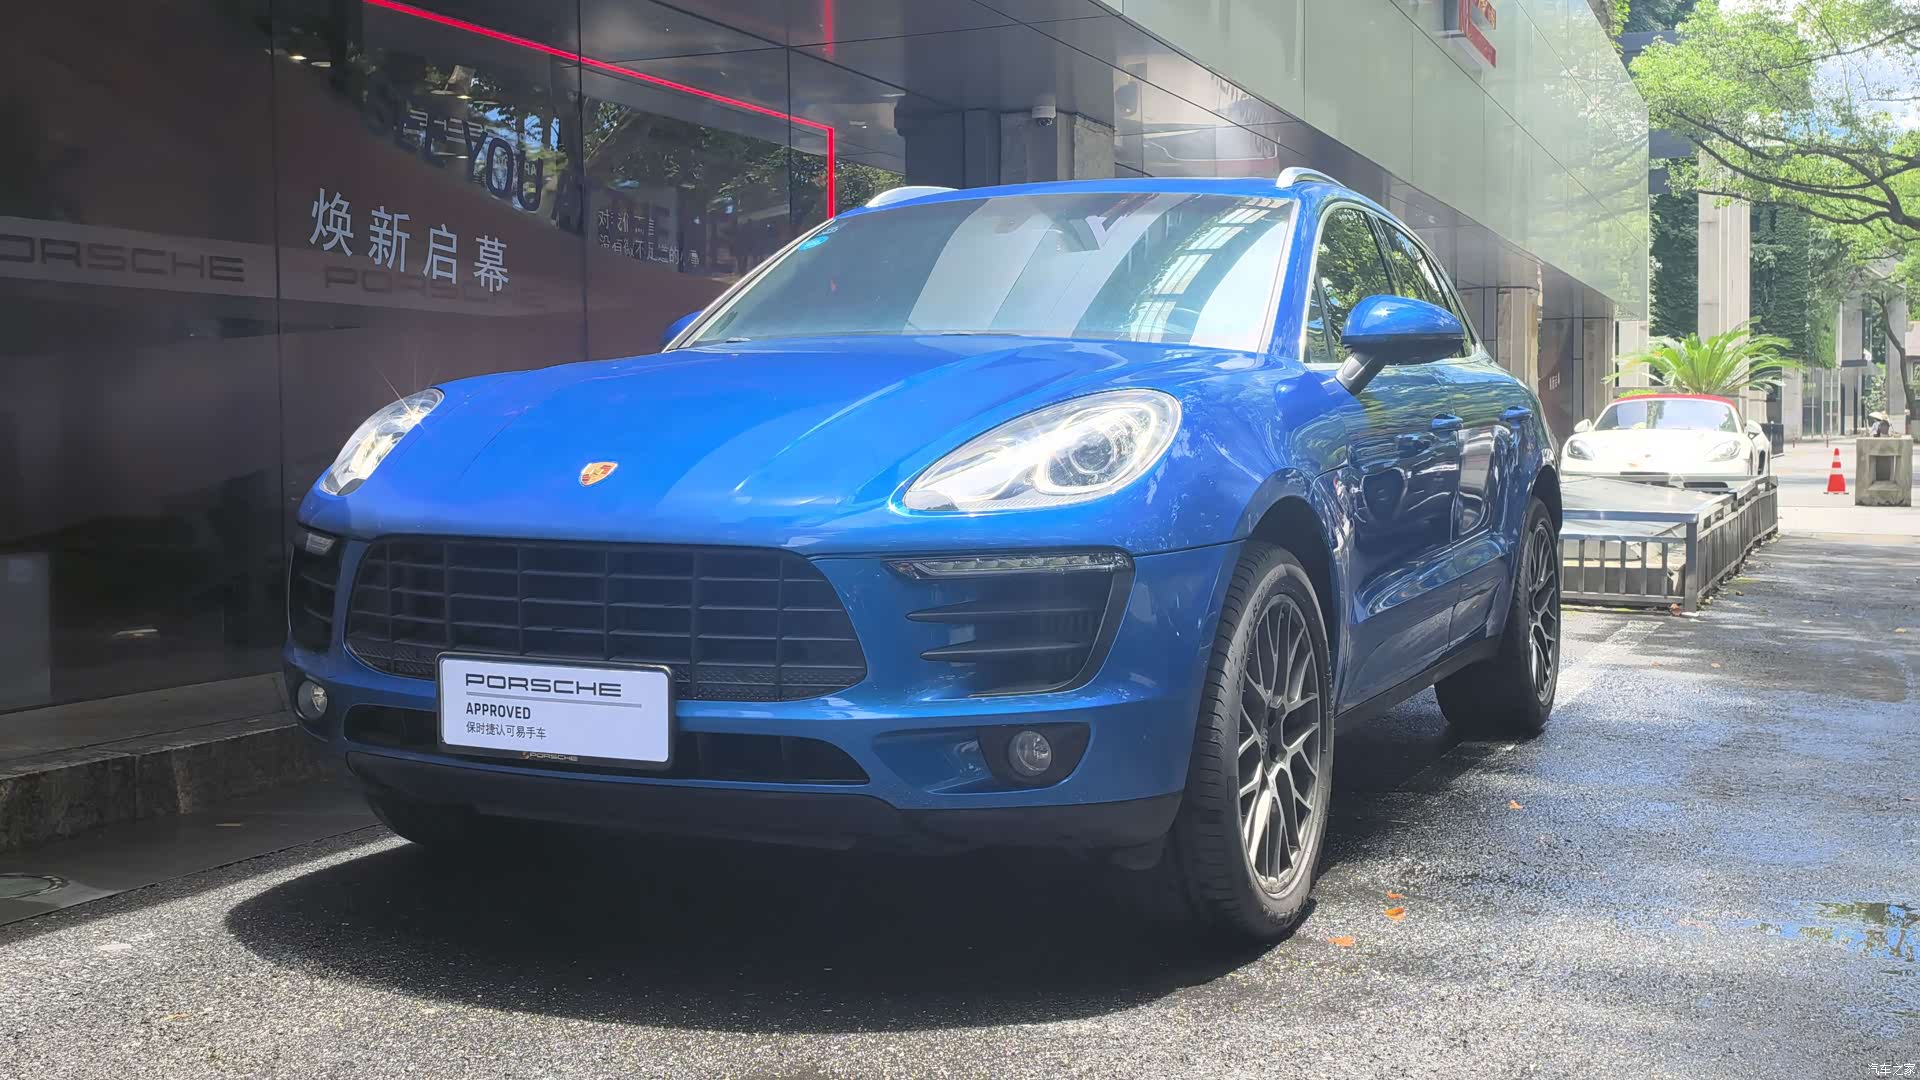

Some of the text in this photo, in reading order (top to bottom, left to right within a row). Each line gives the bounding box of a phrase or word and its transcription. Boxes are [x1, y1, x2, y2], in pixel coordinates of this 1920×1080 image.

[309, 188, 510, 293] 焕新启幕
[465, 673, 622, 698] PORSCHE
[465, 702, 531, 720] APPROVED
[465, 721, 547, 740] 保时捷认可易手车
[529, 752, 579, 762] PORSCHE
